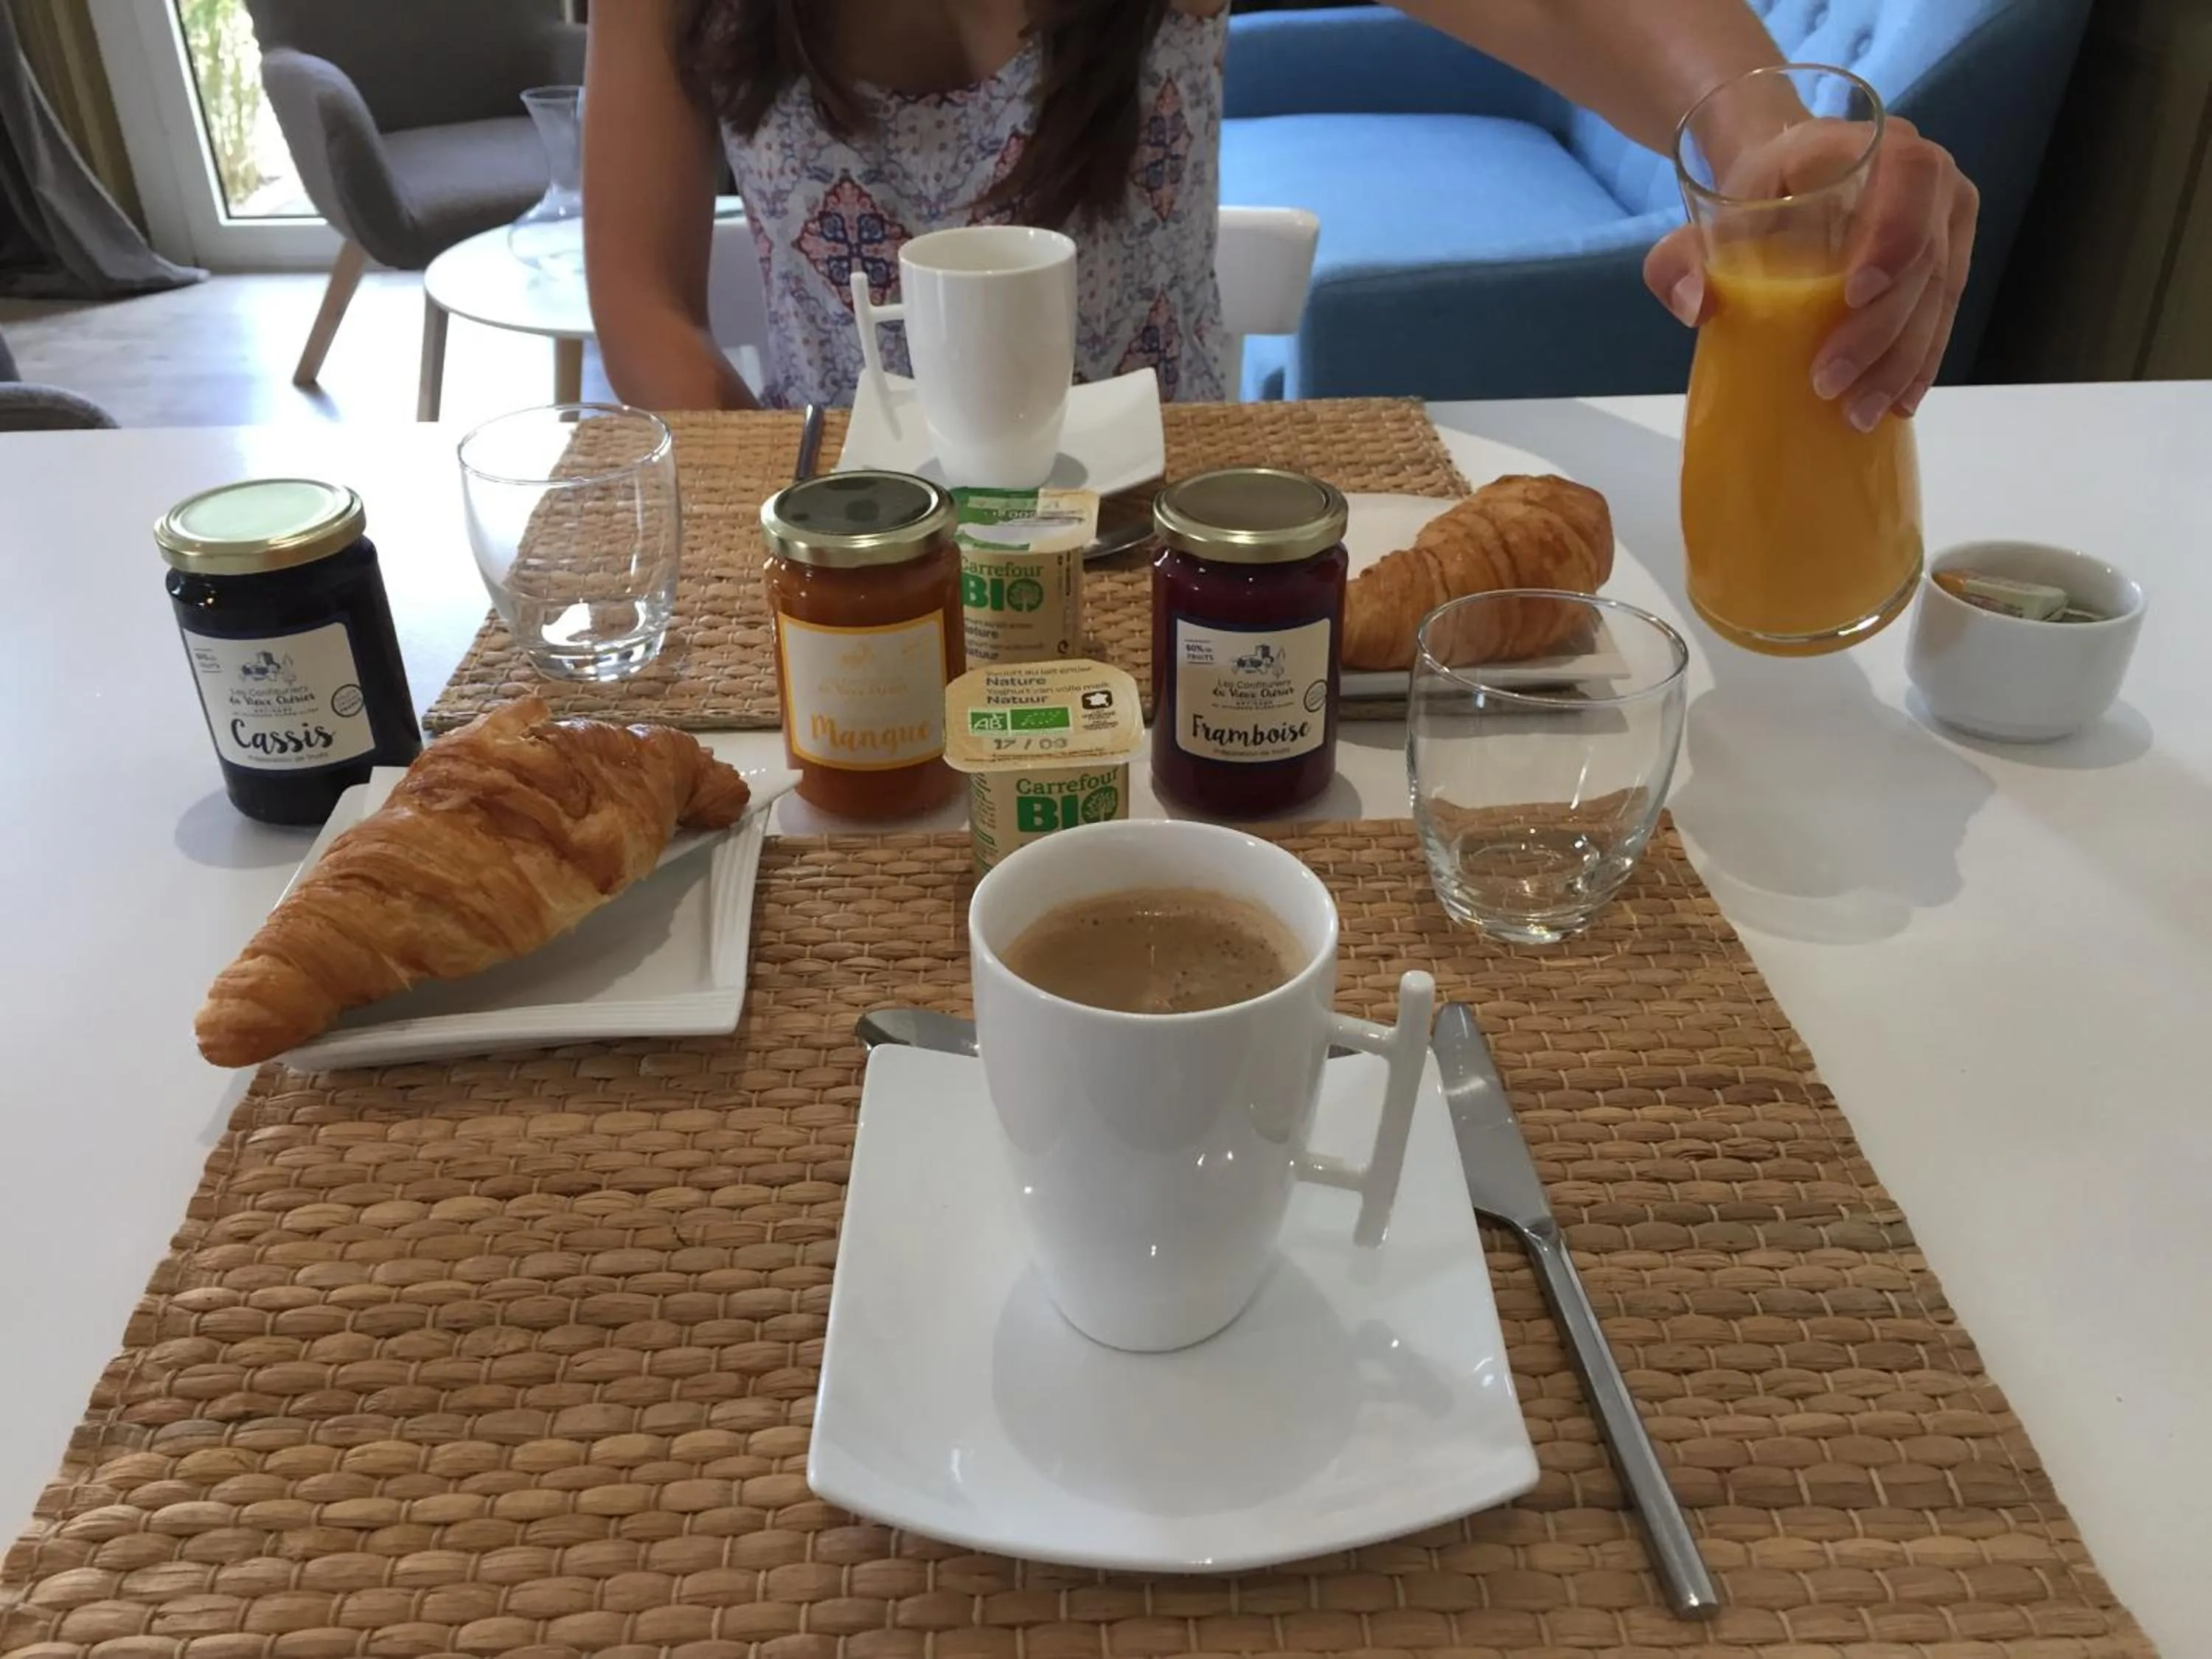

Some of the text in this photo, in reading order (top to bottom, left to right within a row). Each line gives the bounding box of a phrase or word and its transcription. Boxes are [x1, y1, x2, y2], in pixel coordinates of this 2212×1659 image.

[961, 573, 1043, 611] BIO
[965, 626, 999, 639] ature
[965, 648, 999, 660] atuur
[986, 677, 1046, 686] Nature
[987, 695, 1048, 704] Natuur
[231, 718, 337, 755] Cassis
[811, 713, 931, 754] Mangue
[1192, 713, 1311, 748] Framboise
[1016, 767, 1119, 796] Carrefour
[1016, 785, 1119, 833] BIO
